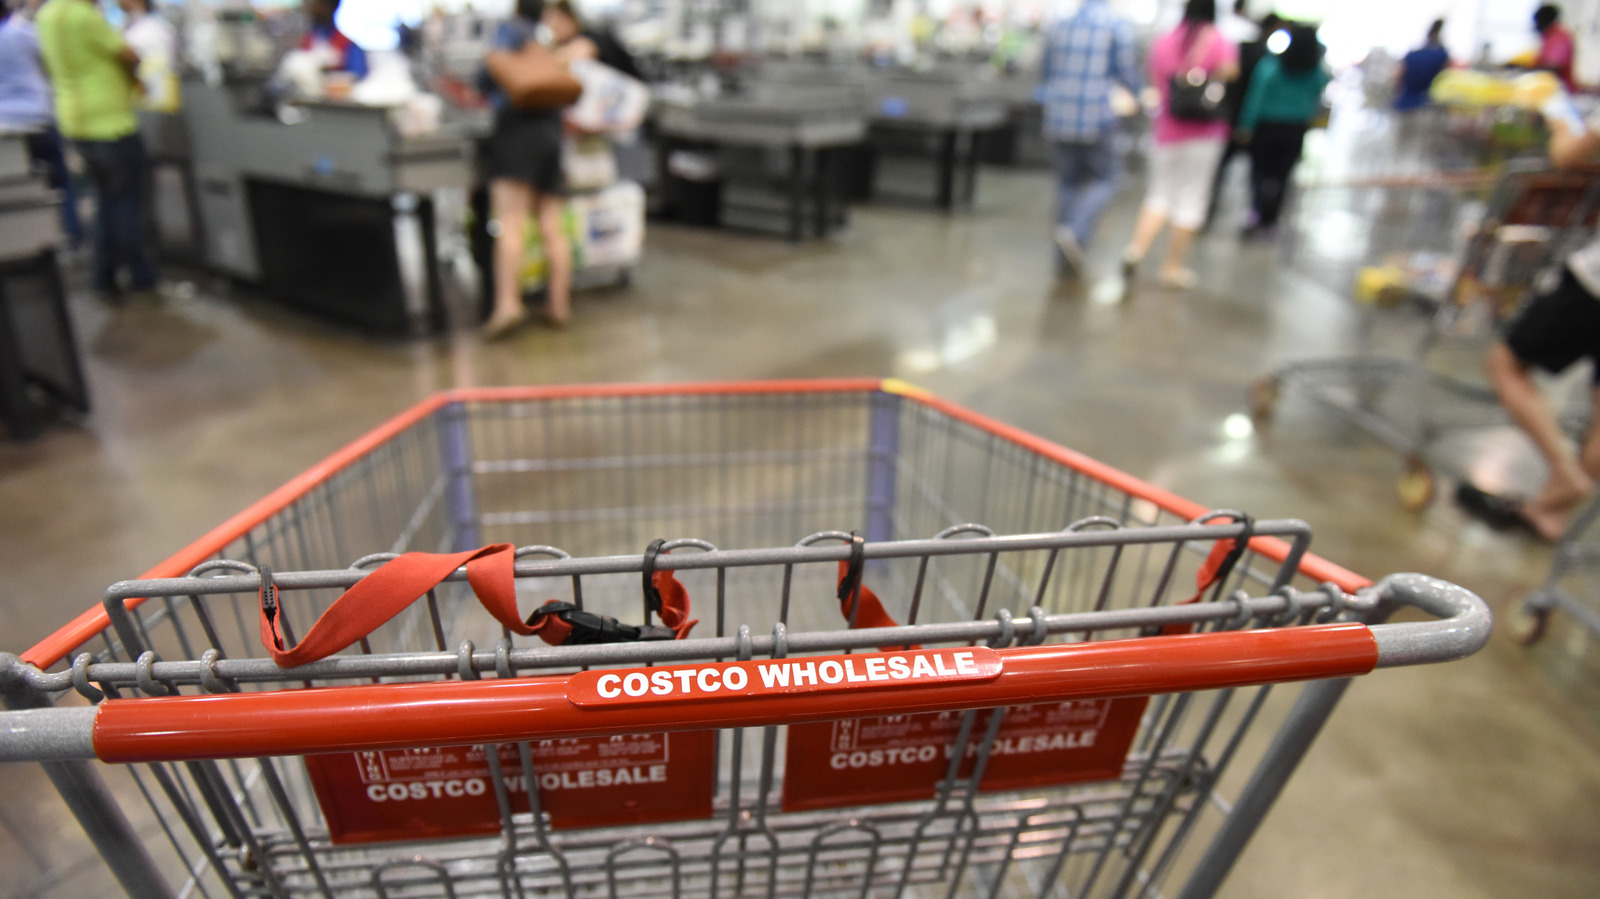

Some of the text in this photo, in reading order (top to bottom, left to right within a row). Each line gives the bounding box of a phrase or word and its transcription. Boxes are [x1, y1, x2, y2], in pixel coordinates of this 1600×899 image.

[596, 651, 980, 698] COSTCO WHOLESALE
[830, 745, 937, 770] COSTCO
[367, 778, 486, 802] COSTCO
